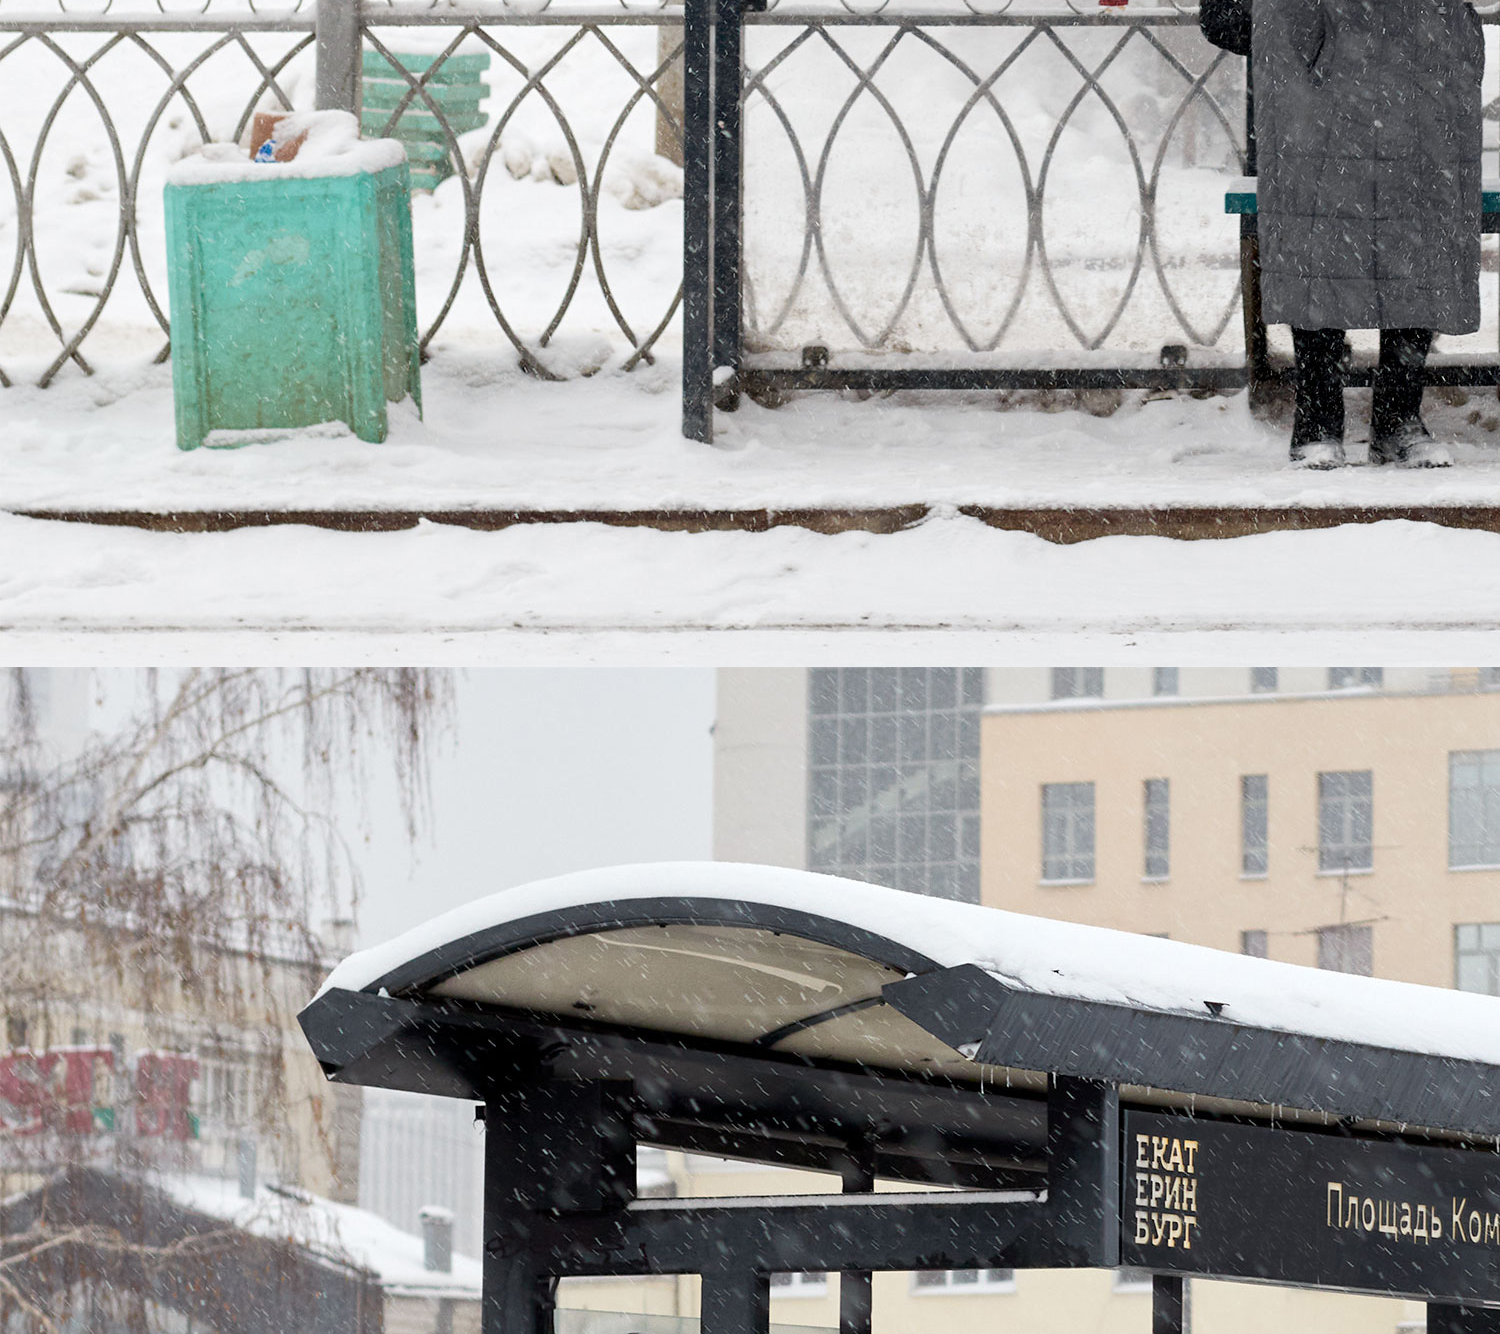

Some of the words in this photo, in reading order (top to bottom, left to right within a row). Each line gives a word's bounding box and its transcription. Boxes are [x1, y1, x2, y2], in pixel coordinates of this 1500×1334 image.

[1136, 1134, 1198, 1171] ЕКАТ
[1136, 1174, 1198, 1210] ЕРИН
[1135, 1211, 1197, 1249] БУРГ
[1326, 1182, 1441, 1244] Площадь
